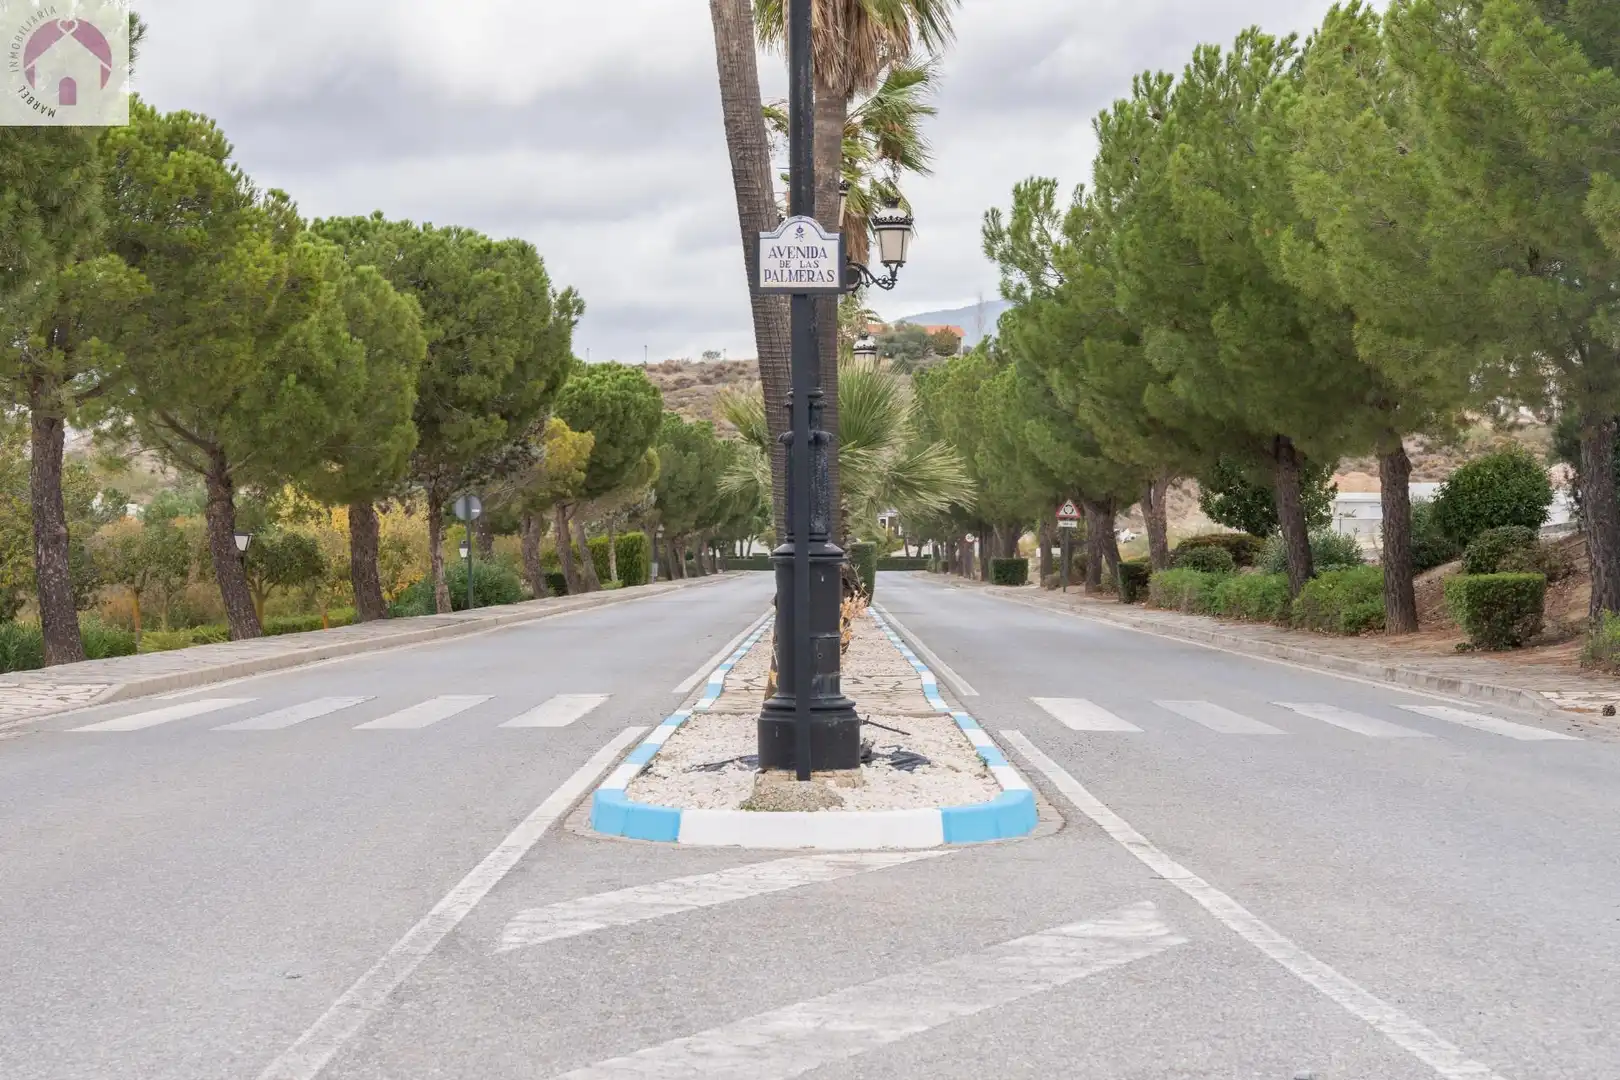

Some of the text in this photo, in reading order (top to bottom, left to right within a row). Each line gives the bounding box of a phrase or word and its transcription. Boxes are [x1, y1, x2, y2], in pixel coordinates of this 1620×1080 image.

[768, 246, 828, 259] AVENIDA
[780, 260, 819, 268] DE LAS
[764, 269, 835, 282] PALMERAS
